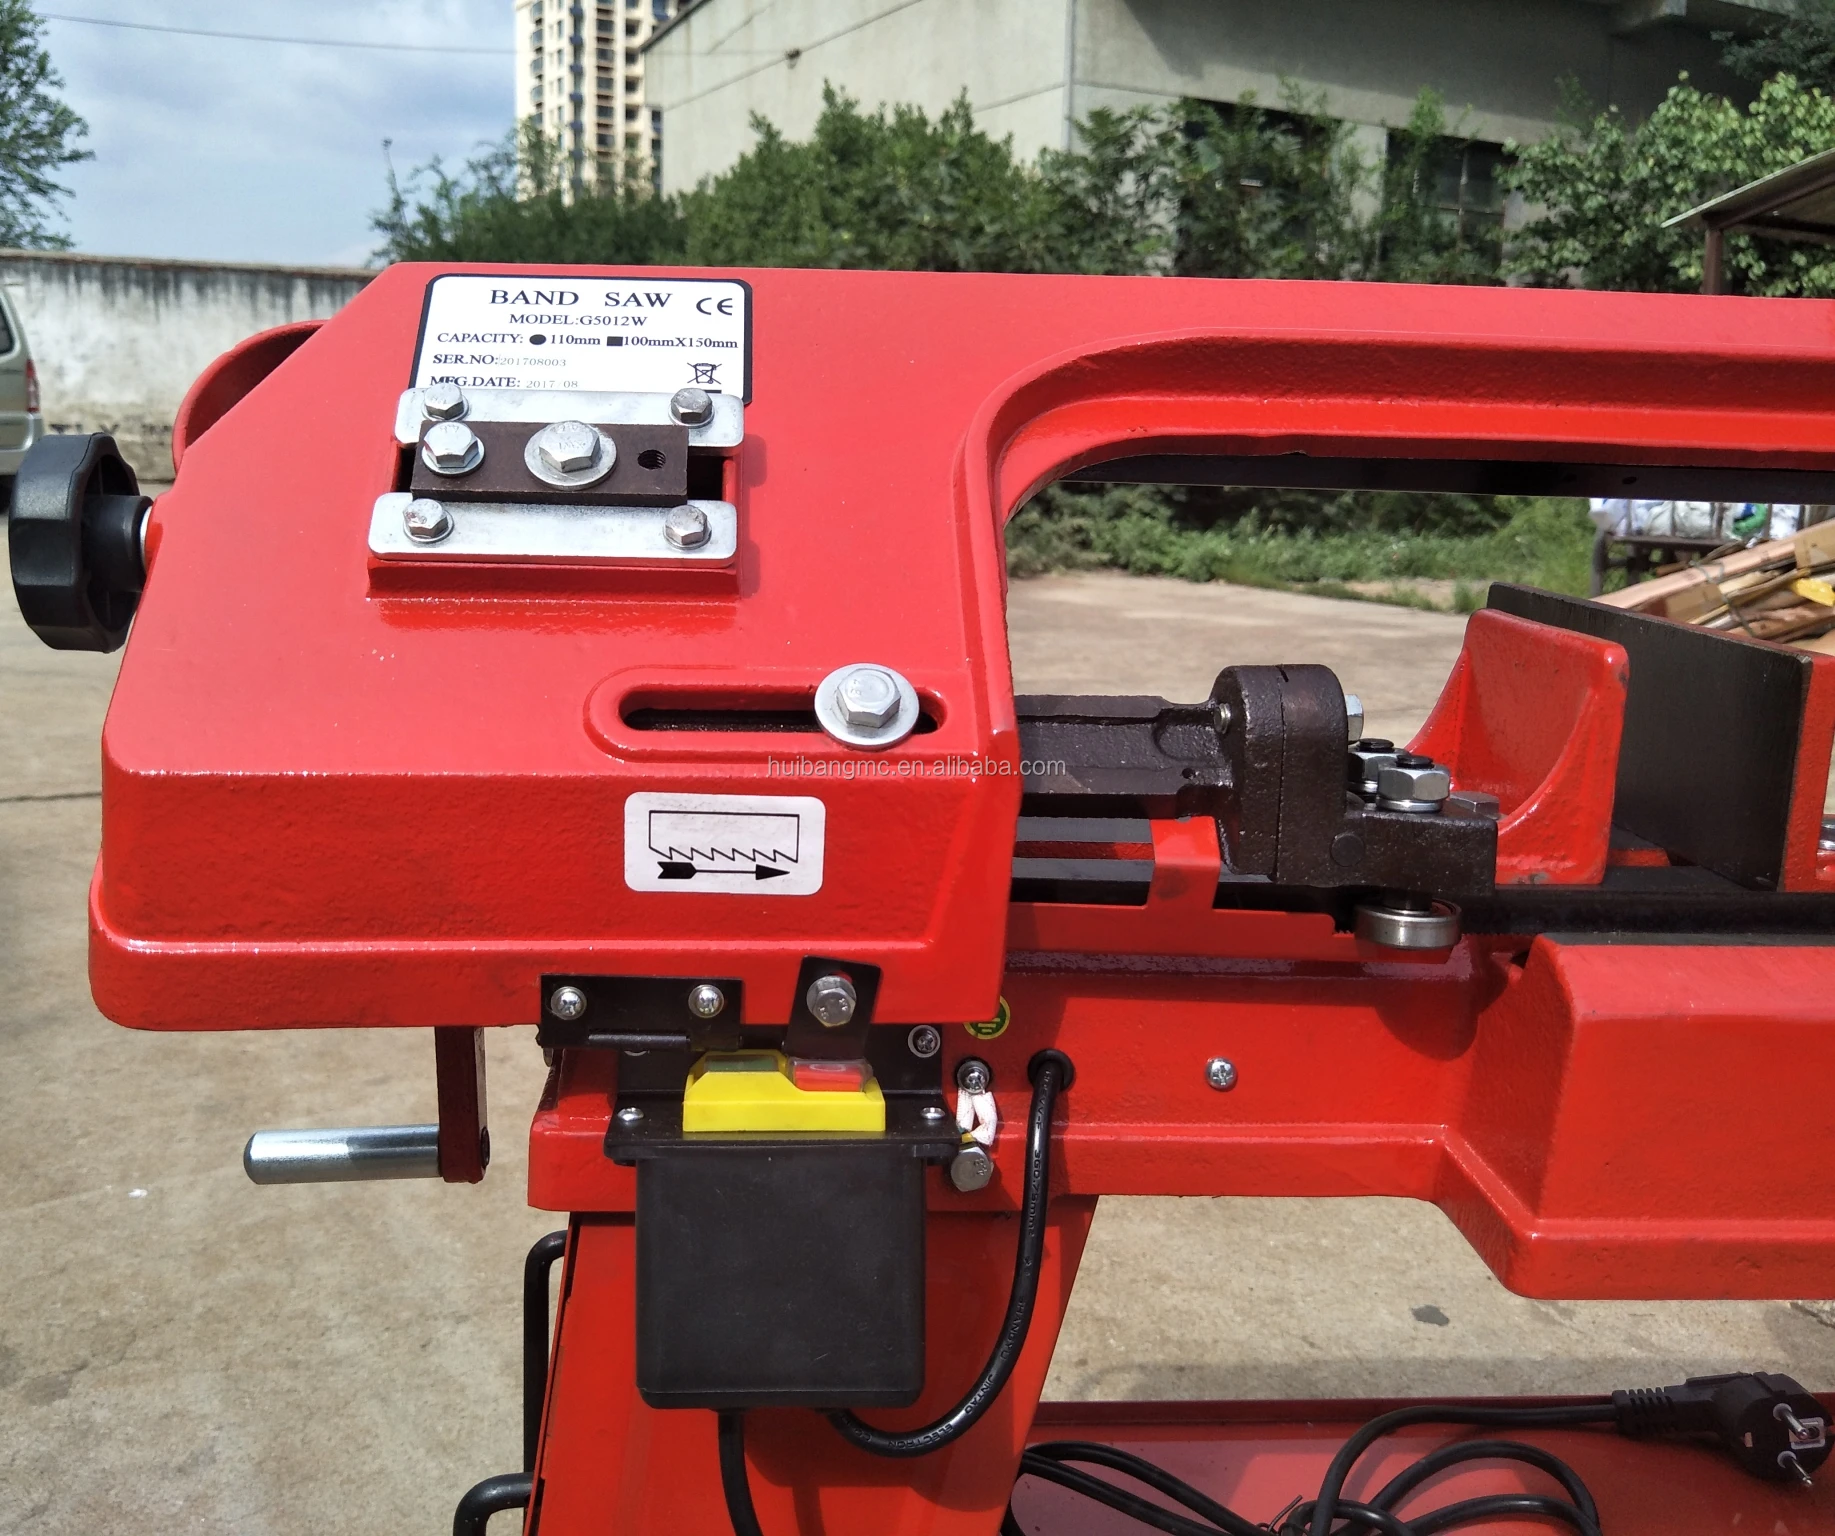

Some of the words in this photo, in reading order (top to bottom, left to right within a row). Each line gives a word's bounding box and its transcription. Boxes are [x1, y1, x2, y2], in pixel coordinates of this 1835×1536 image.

[489, 290, 579, 306] BAND
[604, 292, 673, 308] SAW
[509, 314, 648, 327] MODEL:G5012W
[437, 333, 524, 344] CAPACITY:
[551, 335, 601, 346] 110mm
[624, 336, 739, 348] 100mmX150mm
